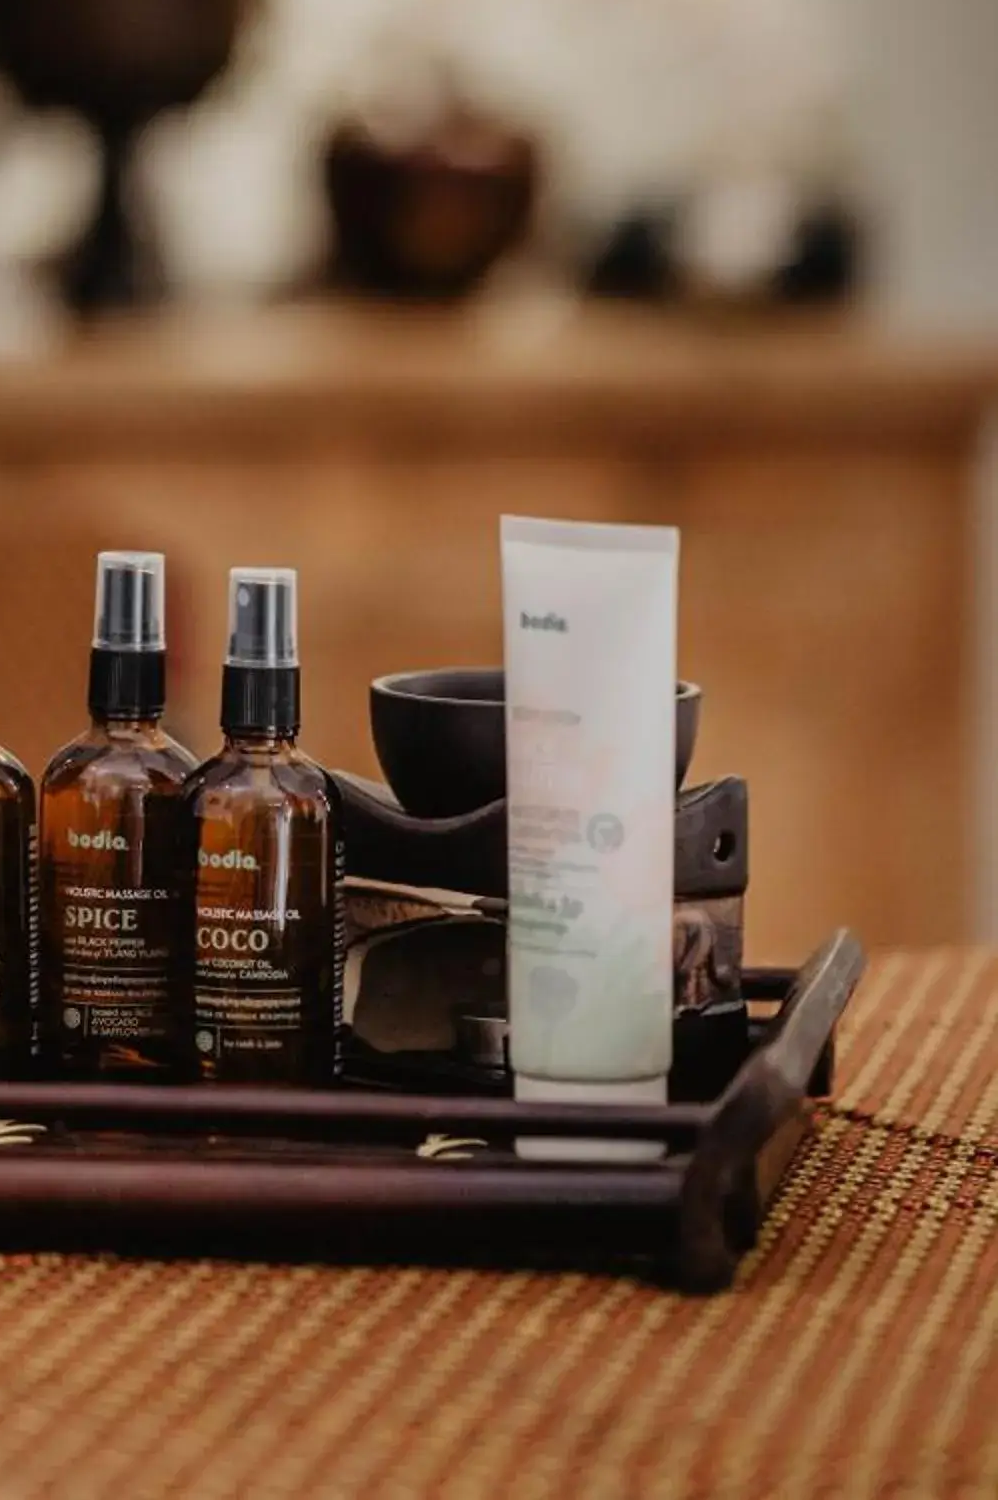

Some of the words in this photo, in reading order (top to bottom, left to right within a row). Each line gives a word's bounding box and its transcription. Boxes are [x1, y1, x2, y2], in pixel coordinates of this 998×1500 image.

[105, 889, 151, 901] MASSAGE
[153, 889, 168, 899] OIL
[64, 905, 138, 931] SPICE
[196, 927, 268, 951] COCO
